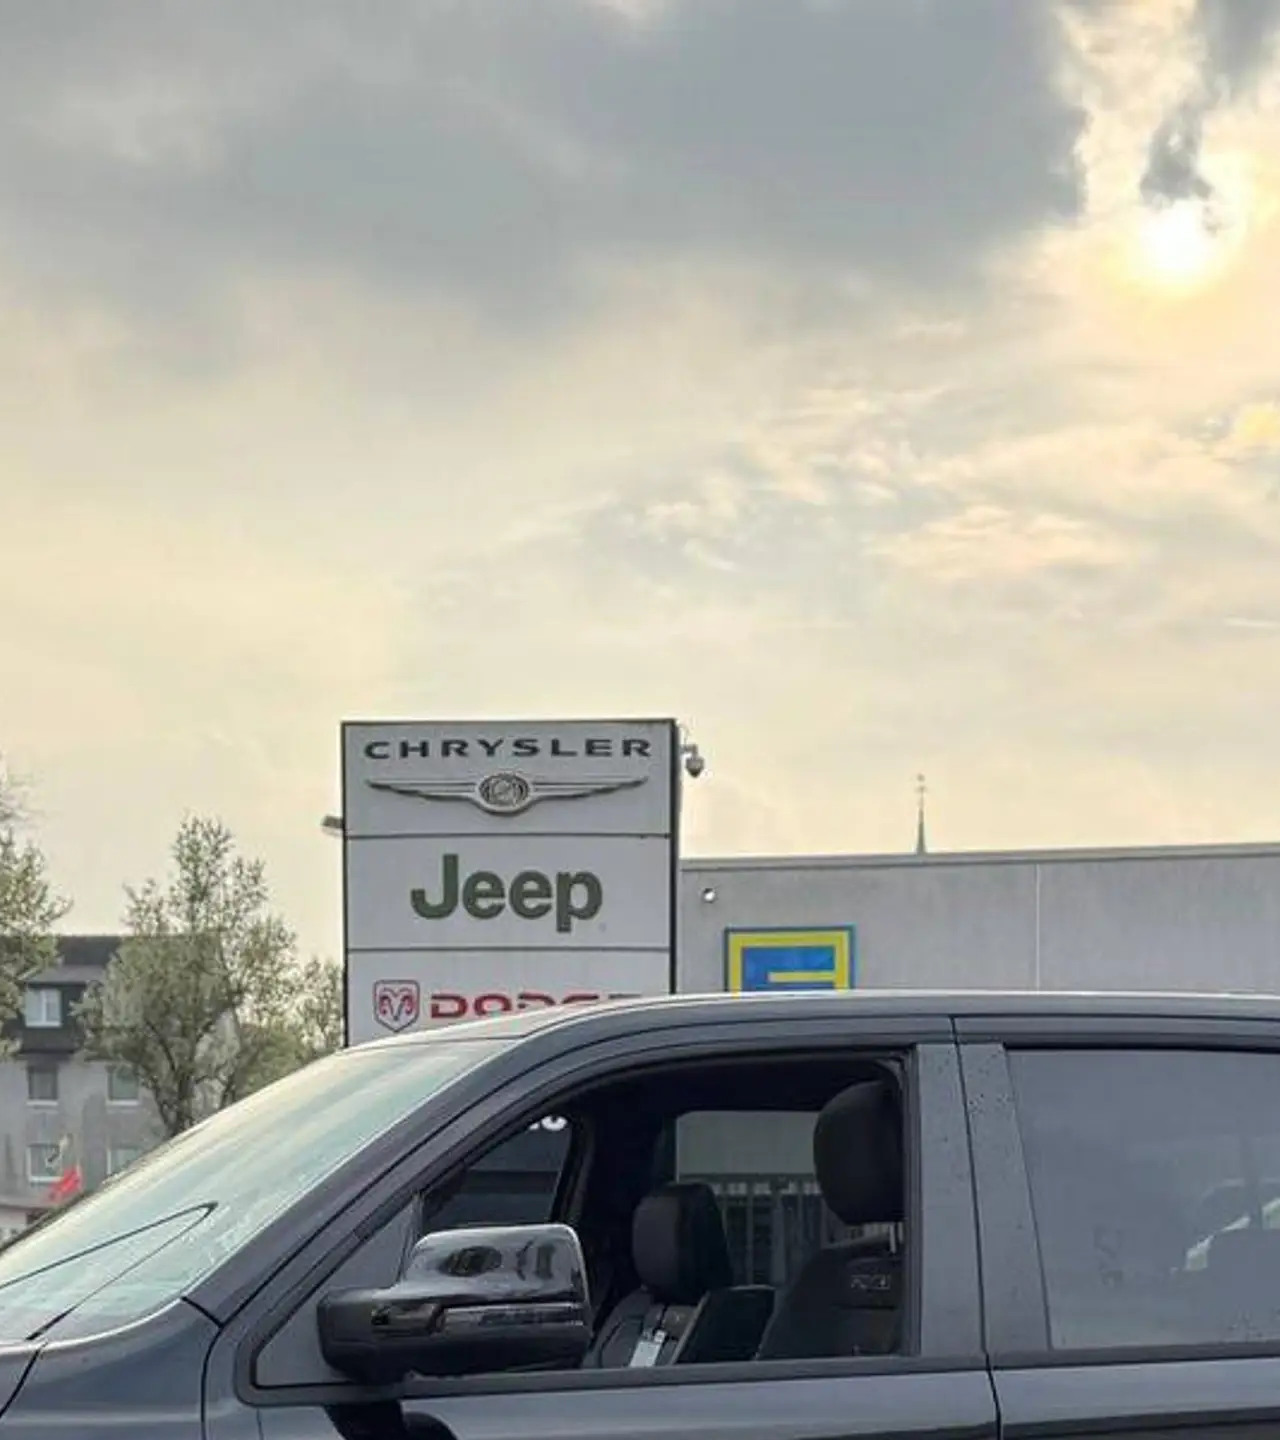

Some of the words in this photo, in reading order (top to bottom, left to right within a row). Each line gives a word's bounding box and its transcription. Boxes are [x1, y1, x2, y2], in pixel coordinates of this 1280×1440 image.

[364, 738, 652, 760] CHRYSLER
[410, 853, 603, 933] Jeep
[430, 993, 641, 1018] DOD
